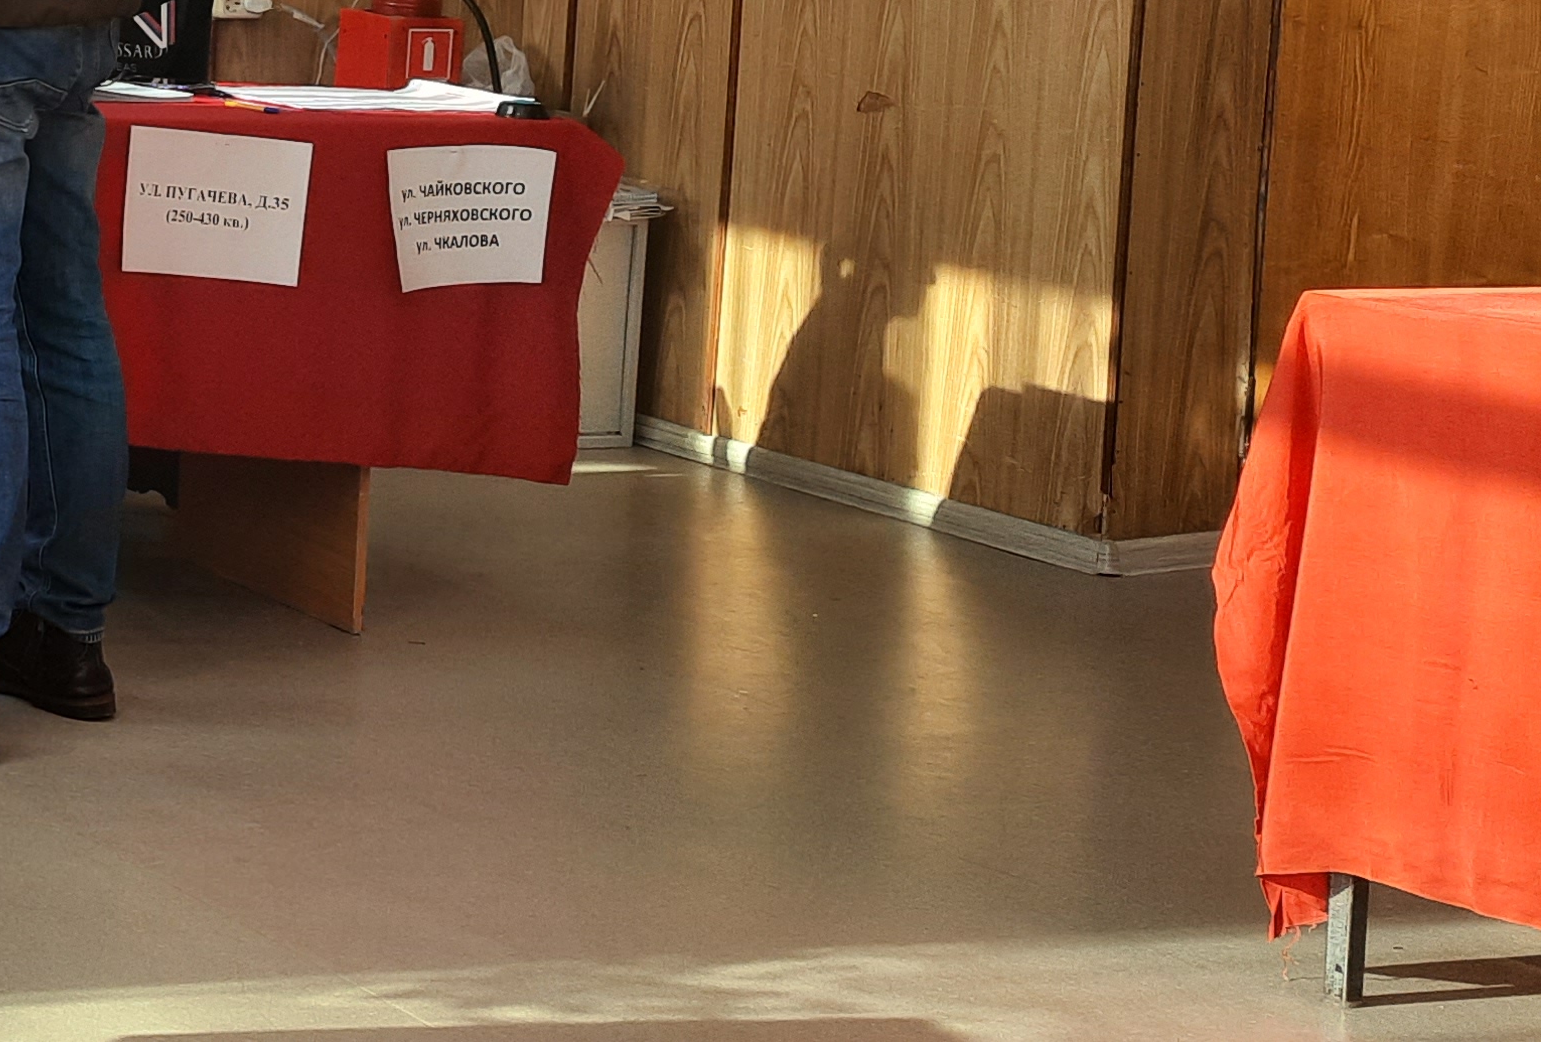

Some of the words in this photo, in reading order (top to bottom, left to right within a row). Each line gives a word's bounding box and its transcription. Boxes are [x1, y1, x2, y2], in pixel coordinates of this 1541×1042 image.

[402, 190, 416, 203] ул.
[419, 181, 525, 197] ЧАЙКОВСКОГО
[255, 195, 290, 210] Д.35
[223, 217, 249, 231] кв.)
[399, 217, 412, 230] ул.
[414, 208, 532, 225] ЧЕРНЯХОВСКОГО
[416, 241, 431, 254] ул.
[434, 234, 499, 249] ЧКАЛОВА
